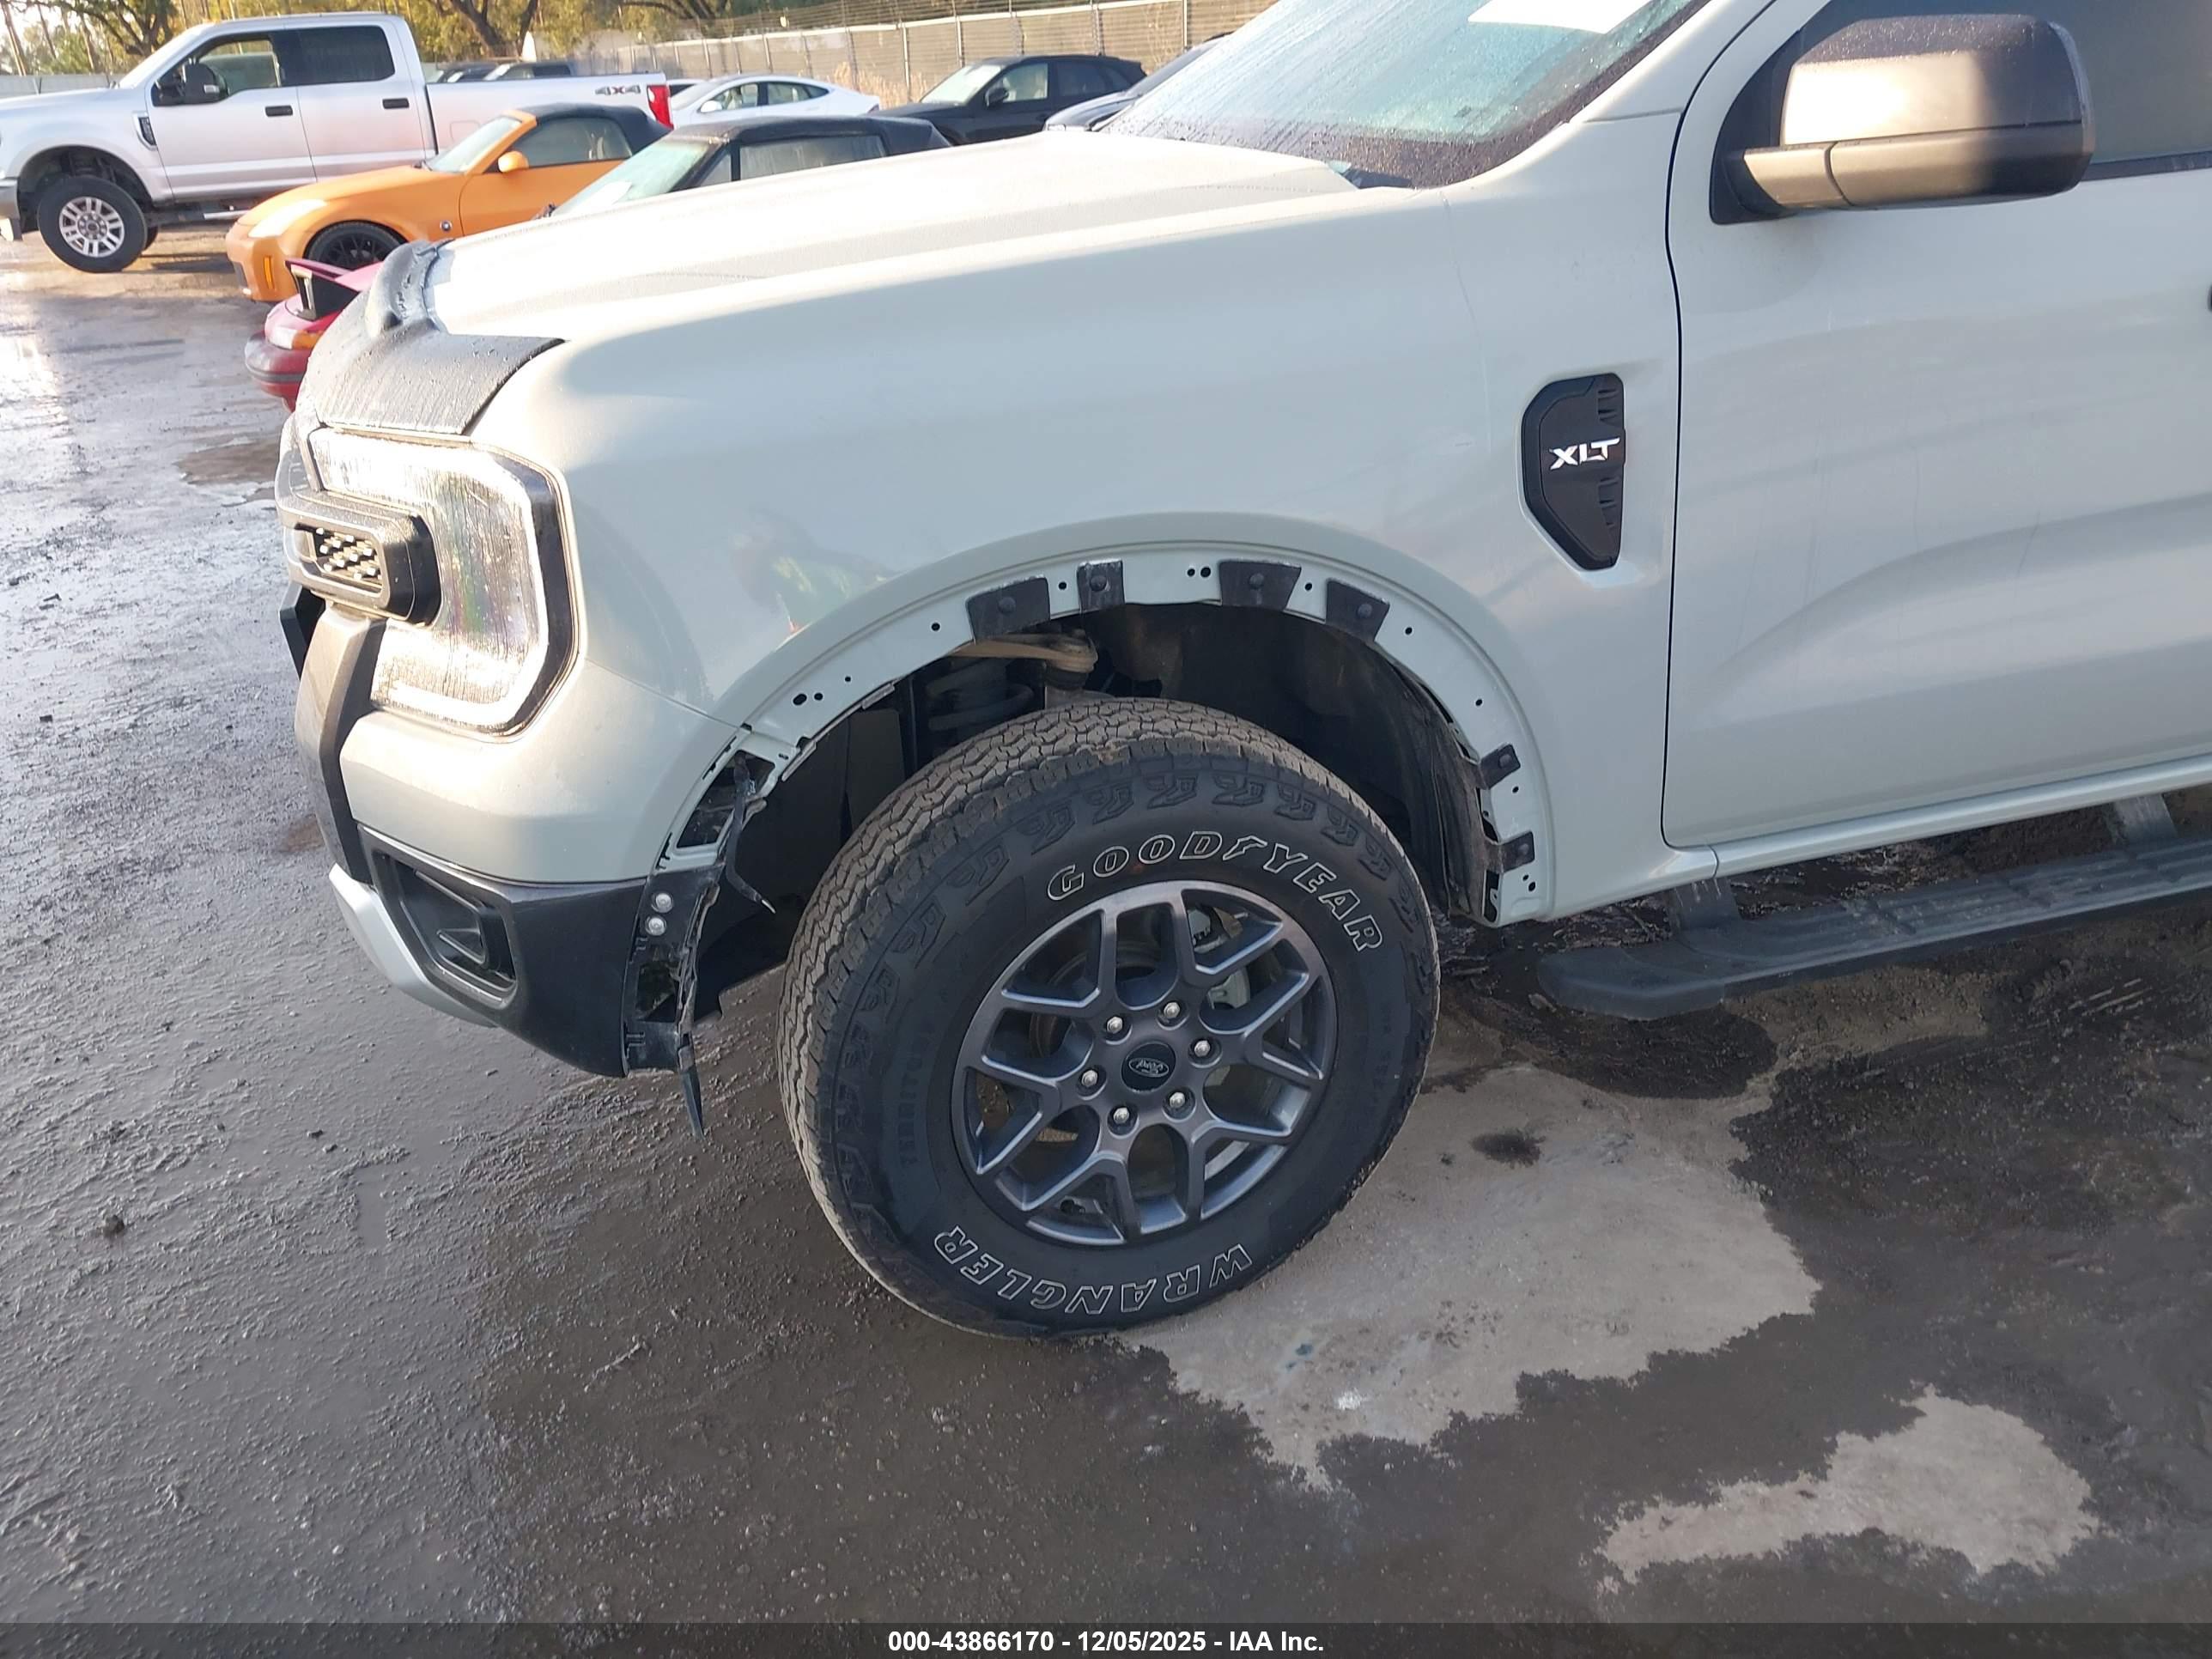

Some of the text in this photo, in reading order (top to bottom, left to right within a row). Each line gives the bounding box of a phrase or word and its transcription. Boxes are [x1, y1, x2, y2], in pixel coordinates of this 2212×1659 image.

[1548, 436, 1621, 471] XLT
[1047, 830, 1383, 952] GOODYEAR
[933, 1224, 1254, 1316] WRANGLER
